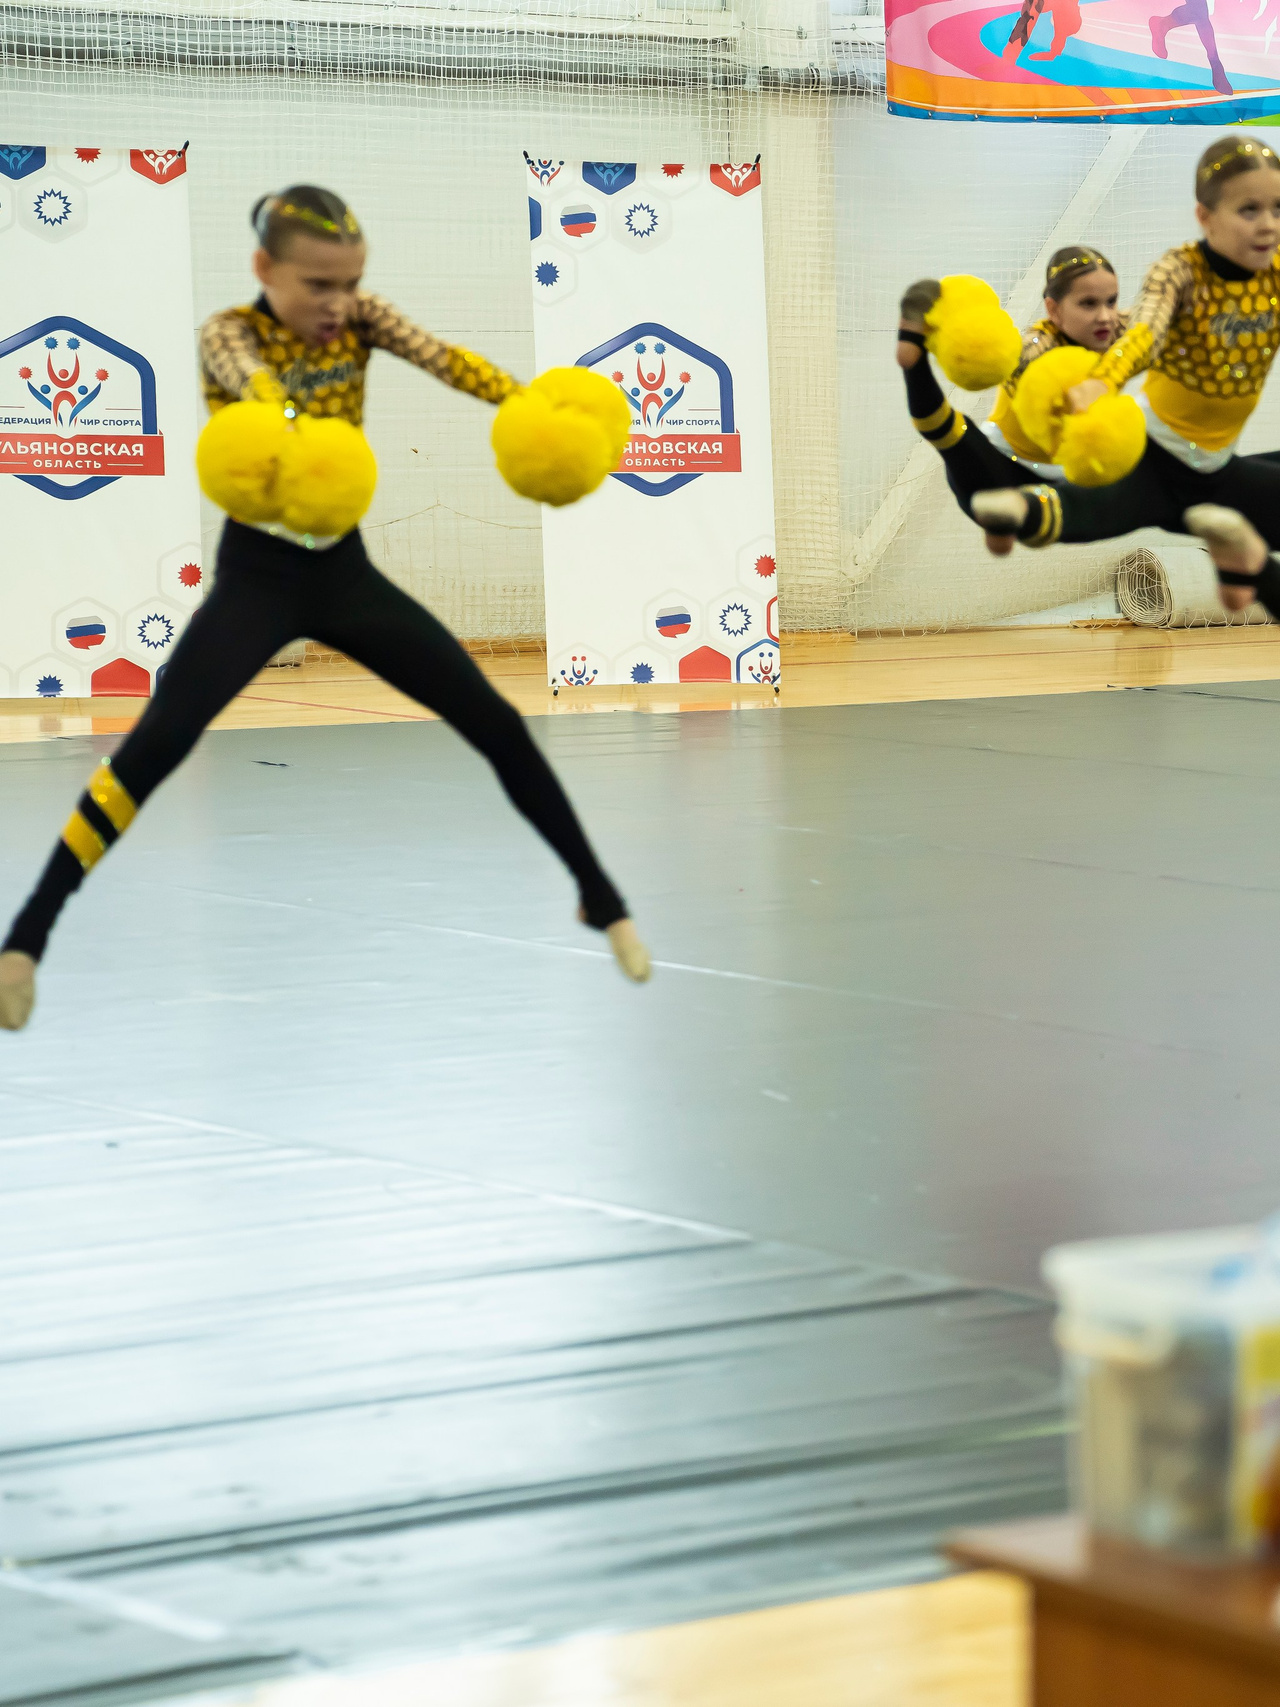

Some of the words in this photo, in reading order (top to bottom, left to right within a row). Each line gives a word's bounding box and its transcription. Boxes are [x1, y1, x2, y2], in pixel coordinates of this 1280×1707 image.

[0, 416, 52, 426] ЕДЕРАЦИЯ
[80, 418, 101, 426] ЧИР
[102, 419, 142, 427] СПОРТА
[0, 441, 144, 457] ЛЬЯНОВСКАЯ
[623, 441, 723, 454] ЯНОВСКАЯ
[33, 459, 102, 469] ОБЛАСТЬ
[625, 458, 686, 467] ОБЛАСТЬ
